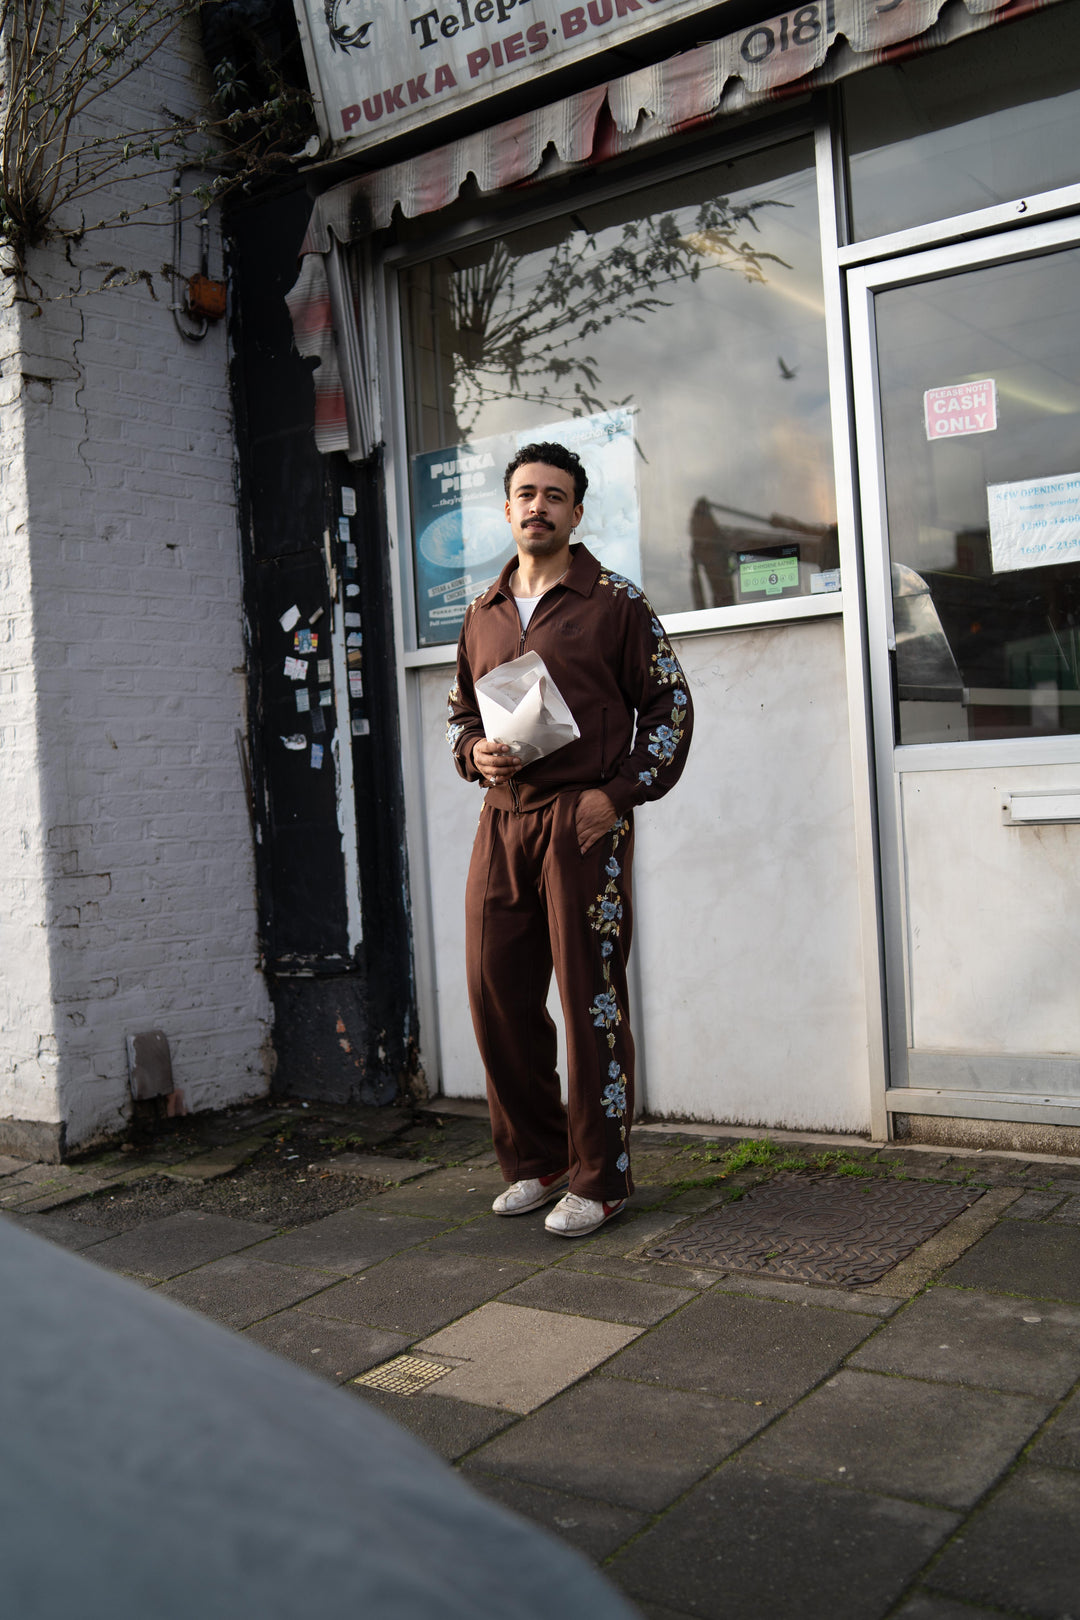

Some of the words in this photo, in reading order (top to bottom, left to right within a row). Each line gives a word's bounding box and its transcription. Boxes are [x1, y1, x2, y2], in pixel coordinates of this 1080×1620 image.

[410, 0, 531, 50] Telep
[340, 64, 458, 132] PUKKA
[466, 21, 549, 78] PIES
[560, 0, 659, 40] BUR
[930, 388, 964, 399] PLEASE
[966, 383, 989, 394] NOTE
[933, 392, 987, 414] CASH
[935, 412, 987, 433] ONLY
[1020, 483, 1064, 497] OPENING
[1049, 498, 1079, 507] Saturday
[770, 574, 777, 584] 3
